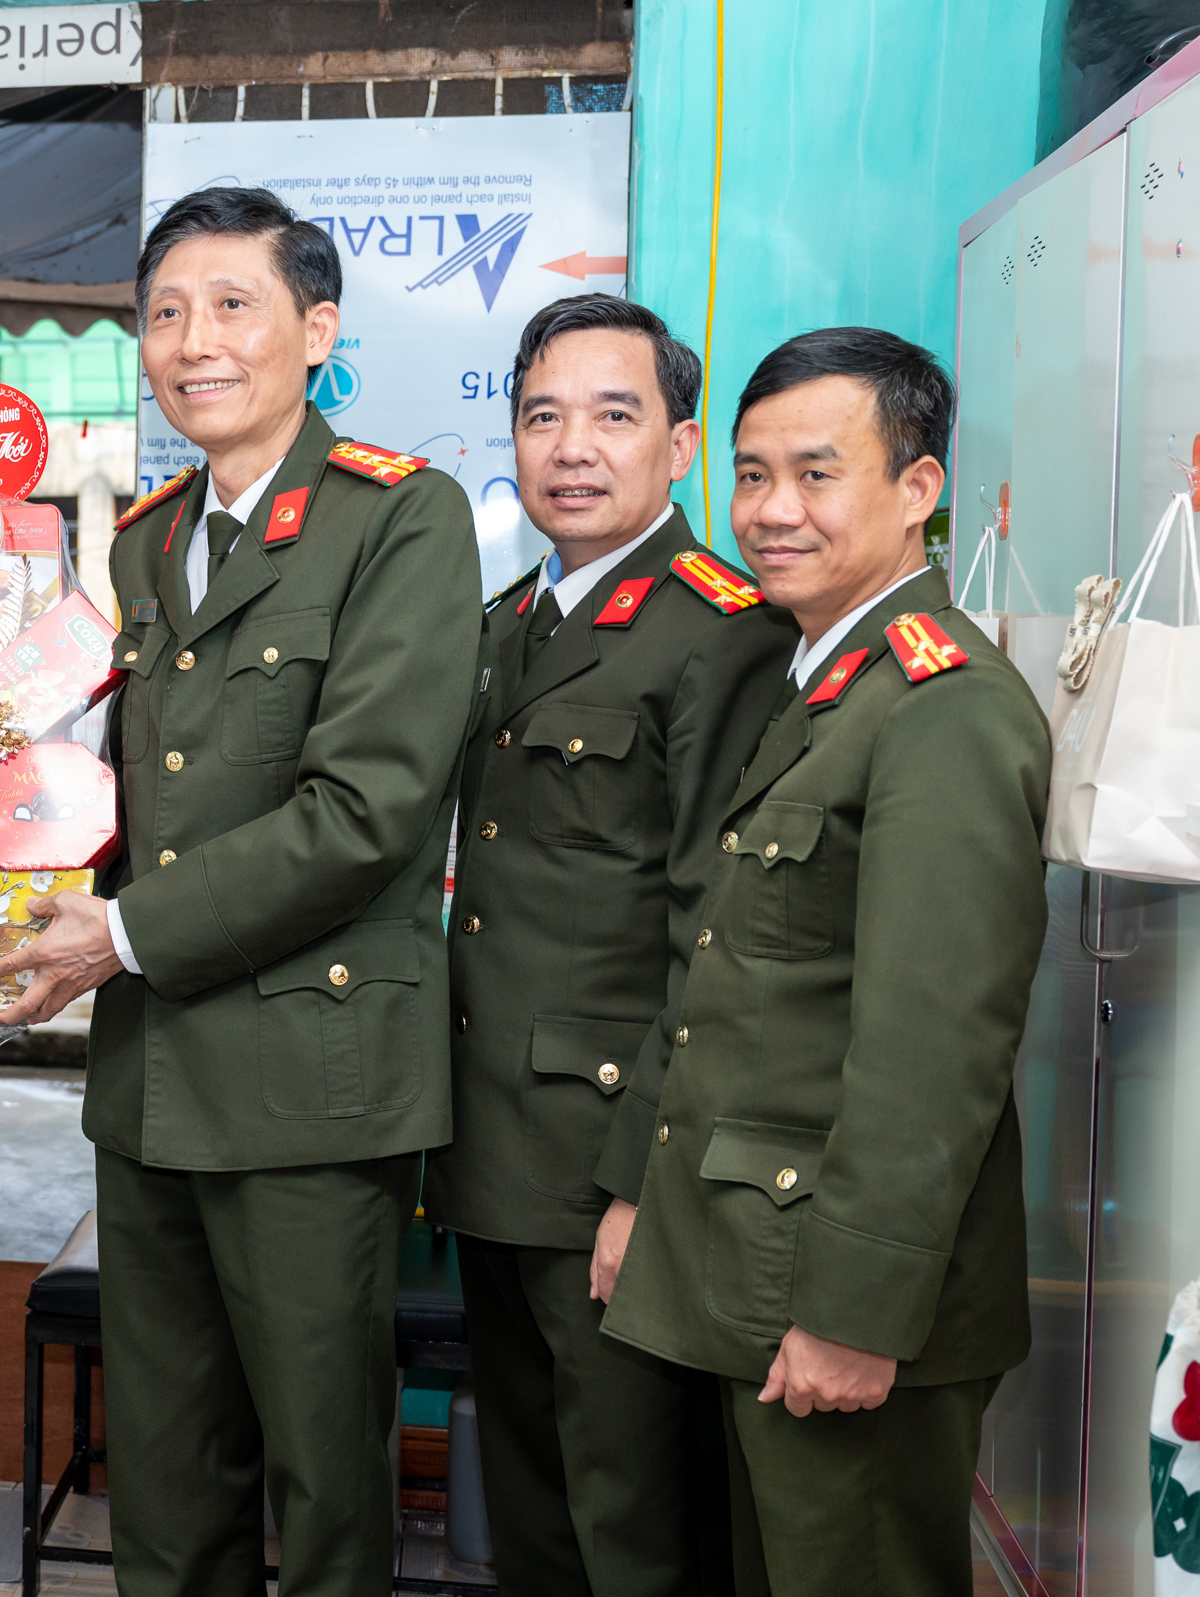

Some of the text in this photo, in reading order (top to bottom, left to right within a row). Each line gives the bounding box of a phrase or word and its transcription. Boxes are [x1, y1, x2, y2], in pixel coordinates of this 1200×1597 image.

[262, 178, 322, 191] installation
[325, 177, 351, 190] after
[355, 174, 381, 190] days
[384, 177, 398, 189] 45
[402, 176, 435, 189] within
[462, 175, 480, 188] the
[484, 174, 532, 188] Remove
[309, 191, 532, 208] Install each panel on one direction only
[172, 455, 200, 468] each
[16, 648, 34, 667] TEA
[22, 644, 40, 659] ICE
